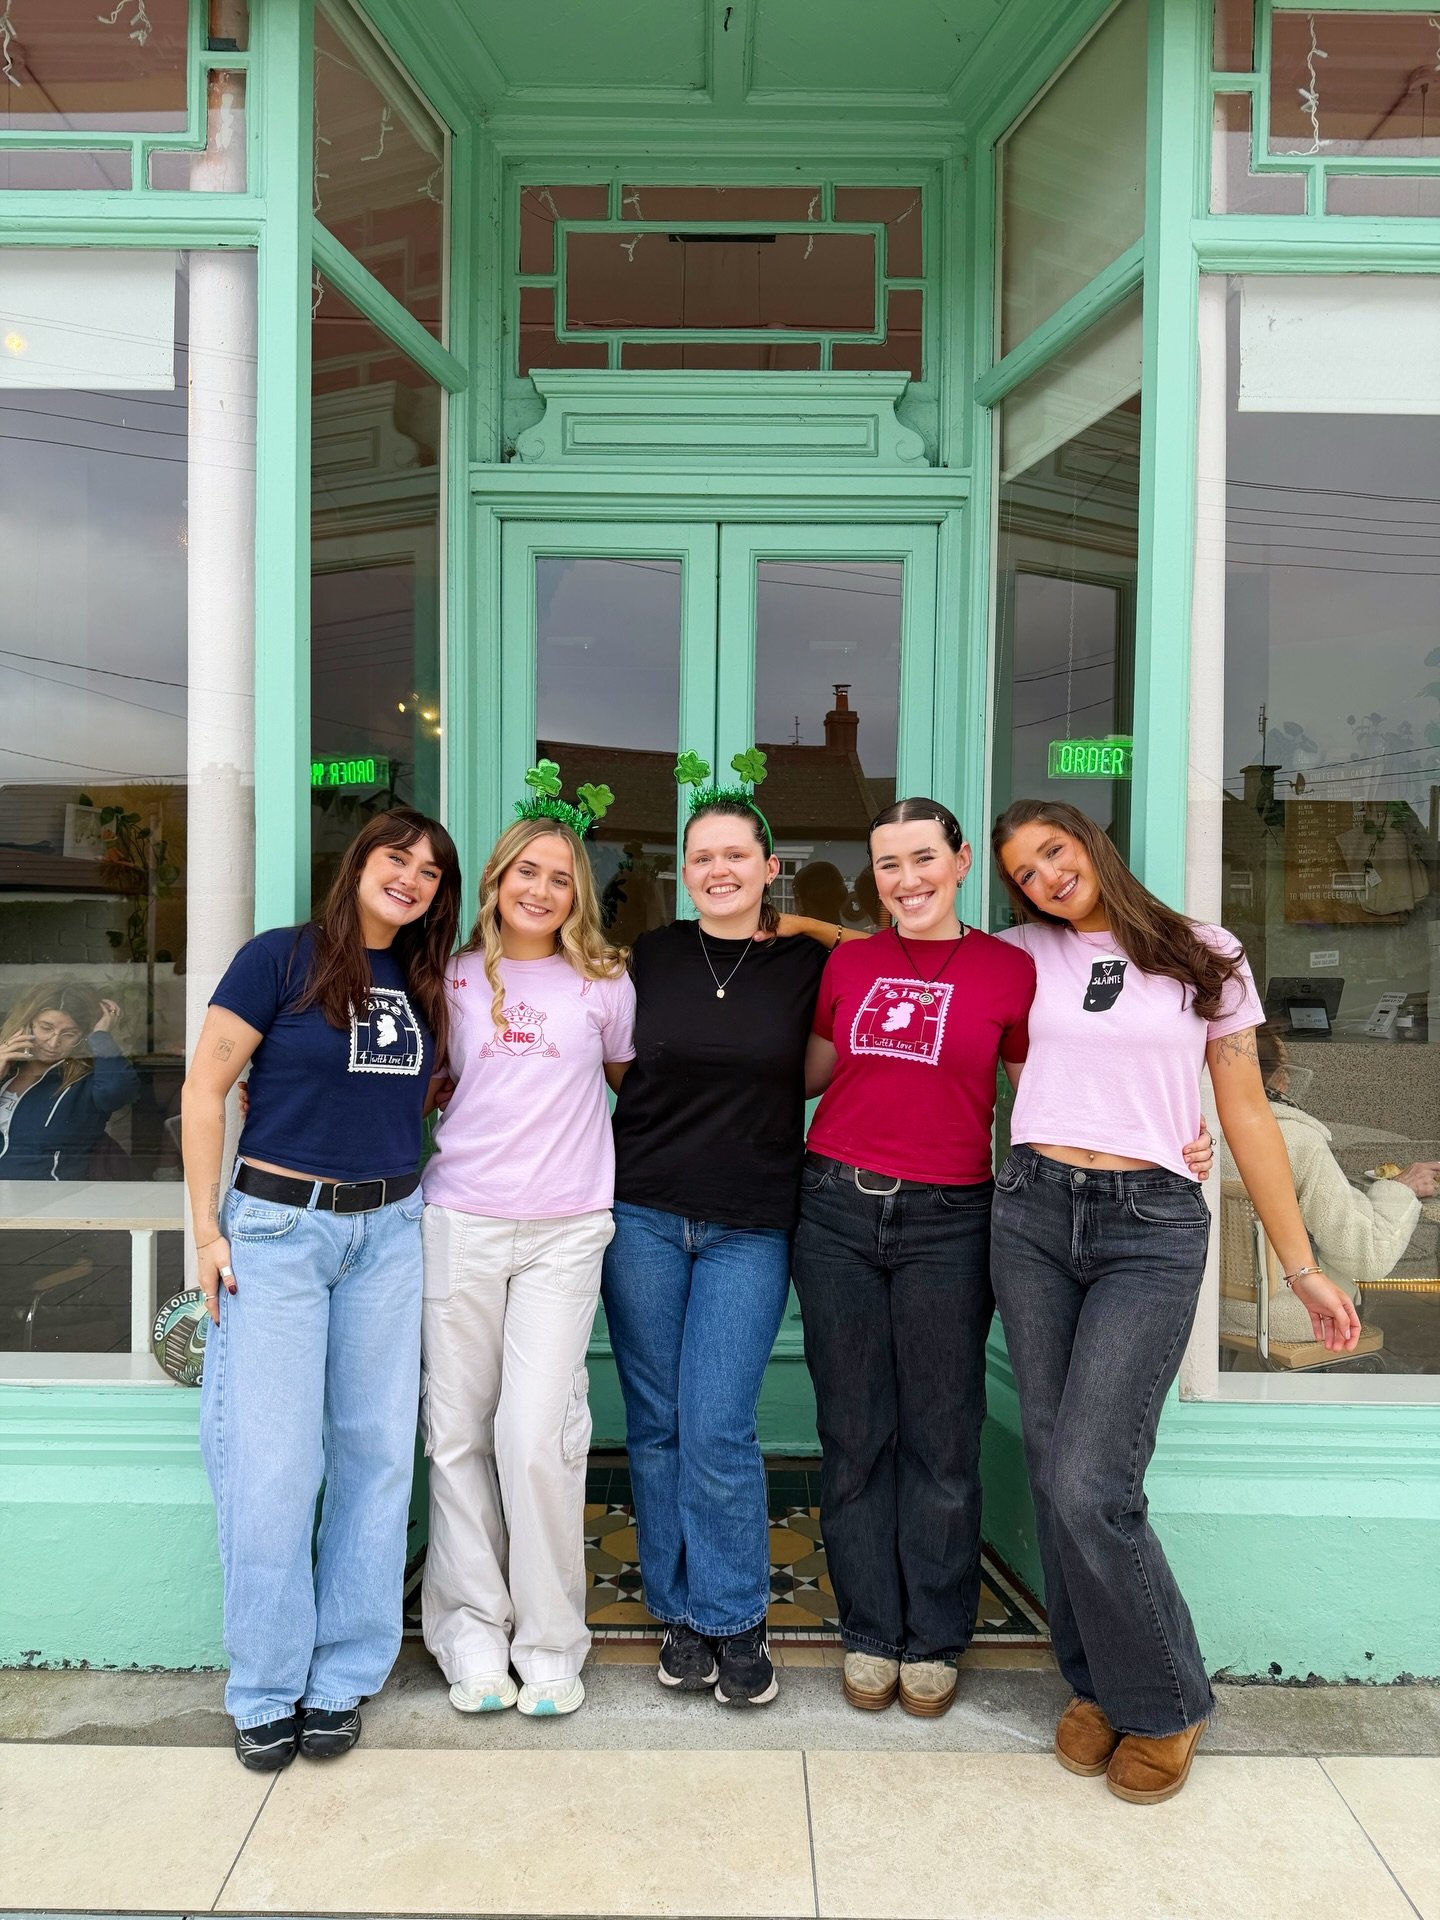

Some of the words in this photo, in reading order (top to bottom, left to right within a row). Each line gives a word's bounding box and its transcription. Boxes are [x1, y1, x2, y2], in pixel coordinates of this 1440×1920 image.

[1060, 745, 1124, 775] ORDER
[452, 978, 467, 989] 04
[502, 1029, 535, 1043] ÉIRE
[859, 1035, 868, 1047] 4
[874, 1038, 894, 1048] with
[896, 1041, 912, 1051] love
[920, 1043, 929, 1055] 4
[359, 1051, 367, 1064] 4
[371, 1054, 387, 1063] with
[388, 1055, 401, 1064] love
[406, 1054, 414, 1067] 4
[154, 1307, 173, 1341] OPEN
[170, 1292, 198, 1308] OUR
